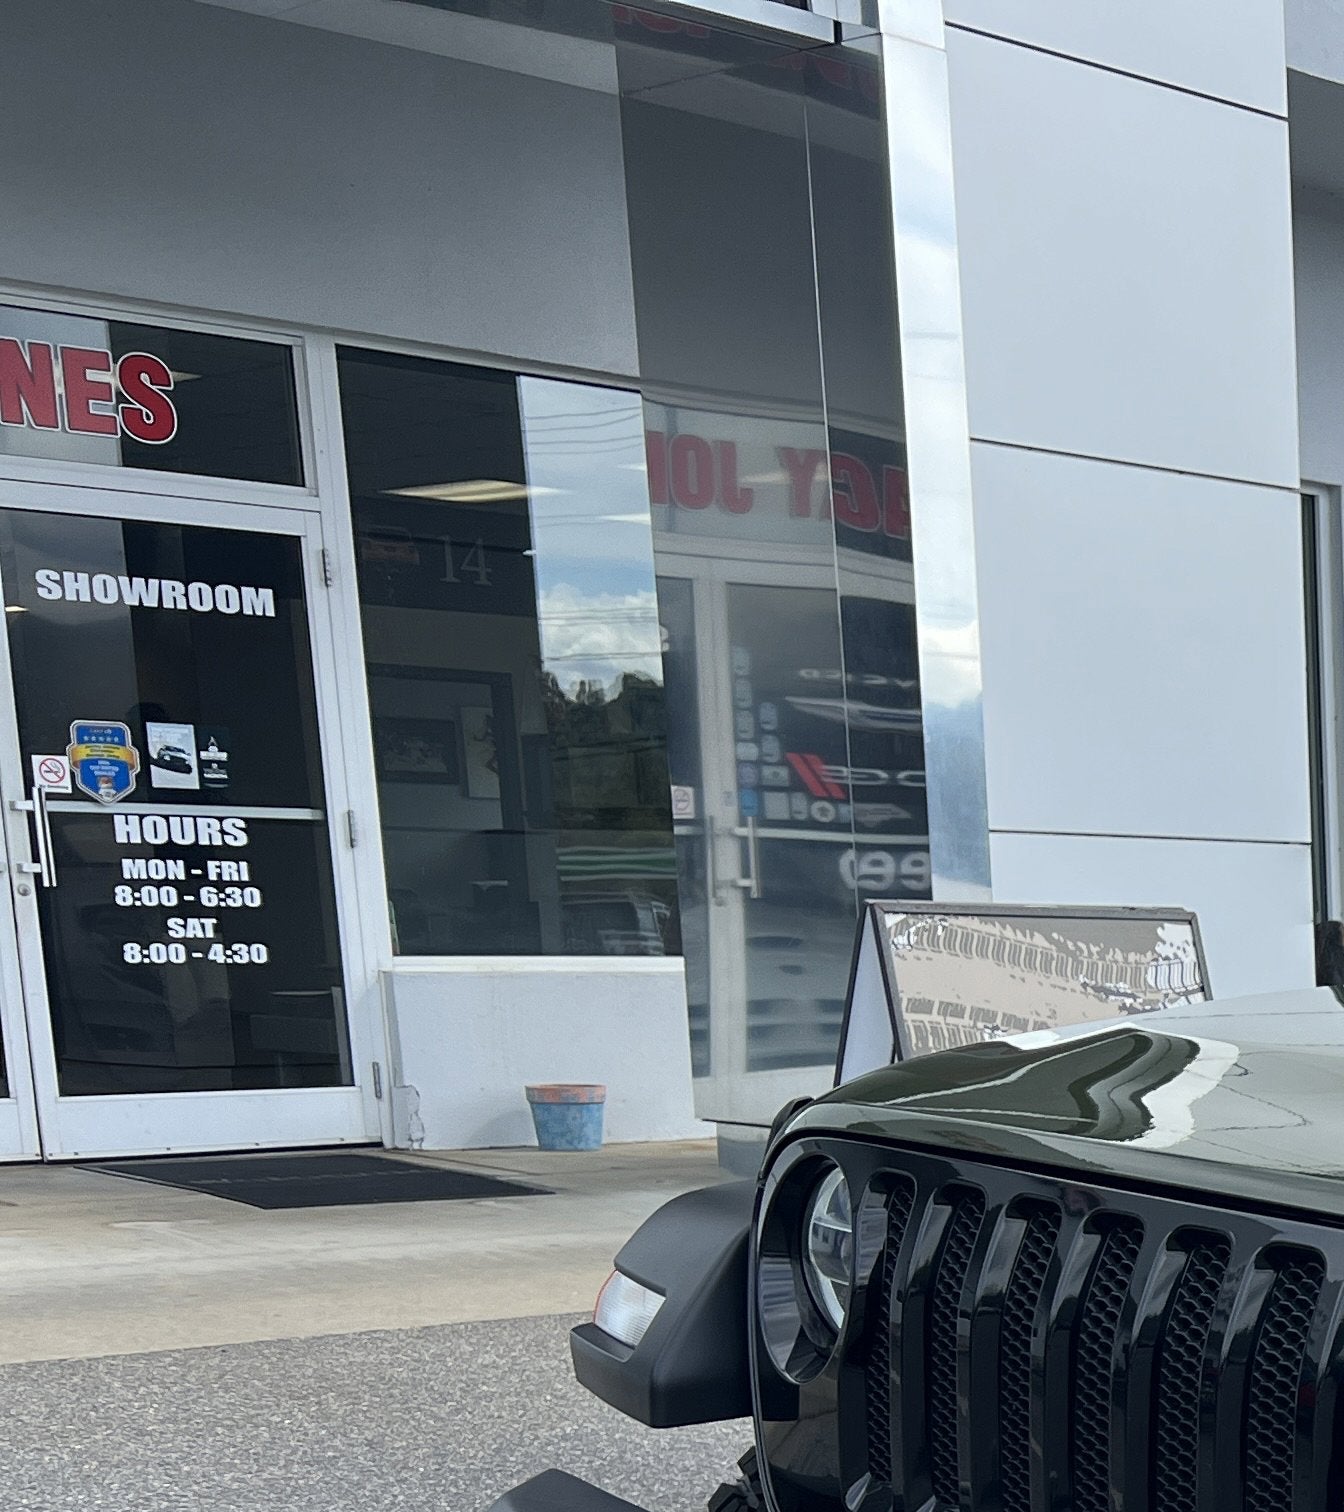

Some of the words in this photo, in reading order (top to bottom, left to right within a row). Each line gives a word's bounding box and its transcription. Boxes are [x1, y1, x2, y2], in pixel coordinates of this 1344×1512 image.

[34, 568, 276, 617] SHOWROOM
[113, 814, 249, 847] HOURS
[121, 858, 186, 881] MON
[207, 860, 249, 882] FRI
[114, 885, 178, 908] 8:00
[199, 886, 262, 908] 6:30
[166, 917, 218, 939] SAT
[123, 942, 187, 964] 8:00
[207, 943, 268, 965] 4:30
